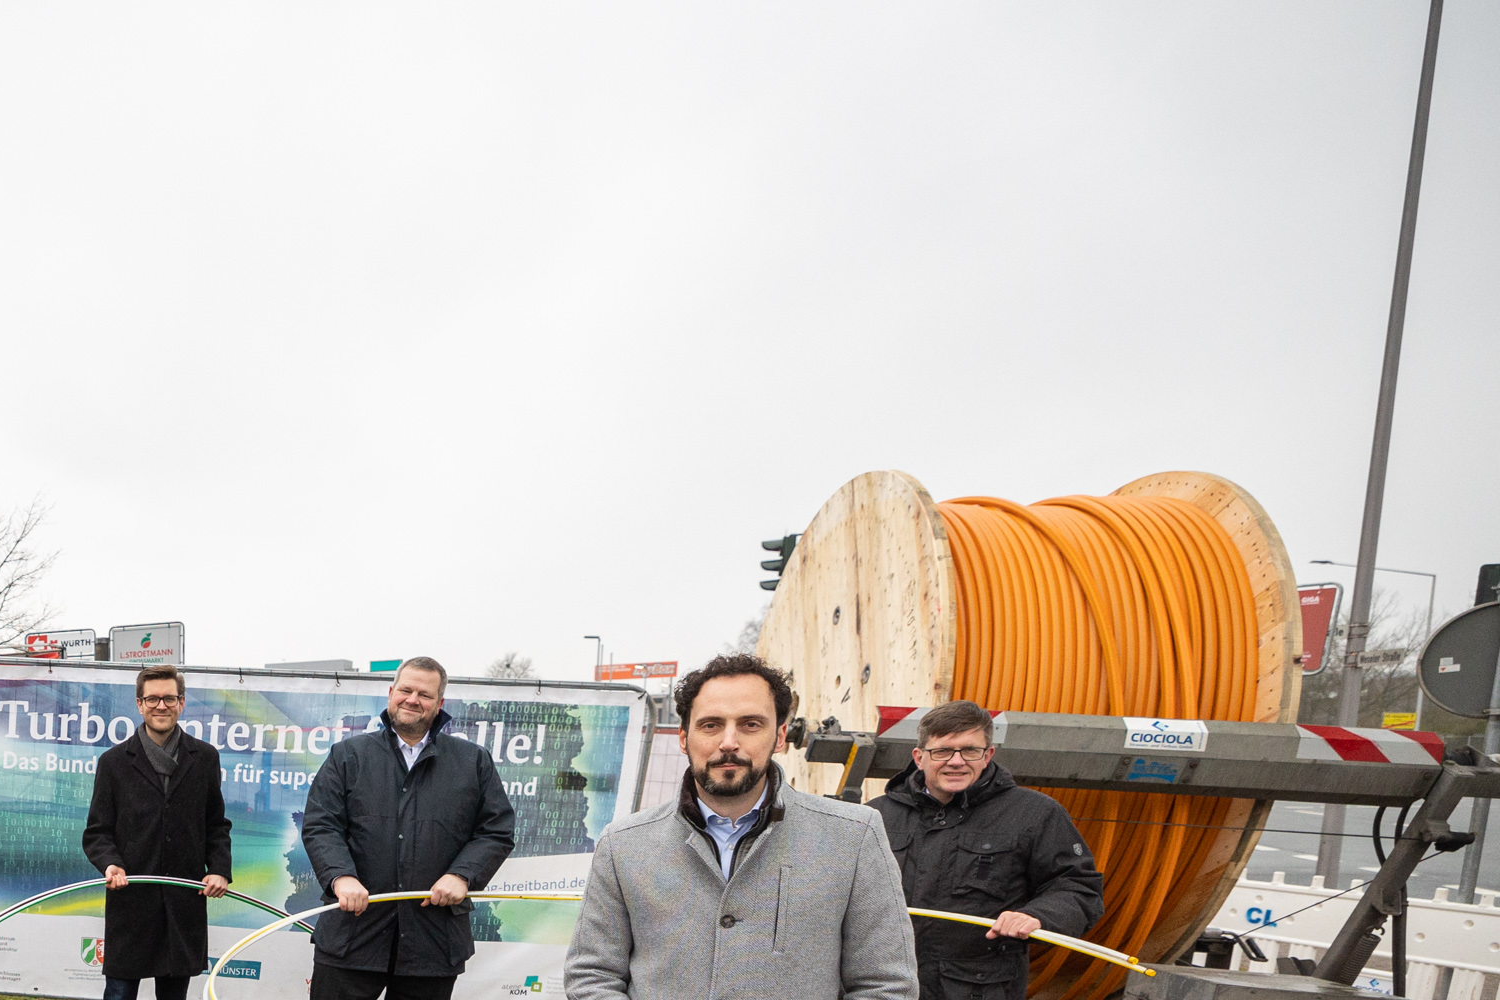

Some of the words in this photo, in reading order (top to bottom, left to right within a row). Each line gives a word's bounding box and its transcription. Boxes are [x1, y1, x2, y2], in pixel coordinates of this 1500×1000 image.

[1131, 732, 1194, 745] CIOCIOLA
[2, 750, 40, 771] Das
[45, 752, 97, 775] Bund
[233, 762, 265, 785] für
[1245, 906, 1279, 929] CL
[509, 988, 528, 996] KOM
